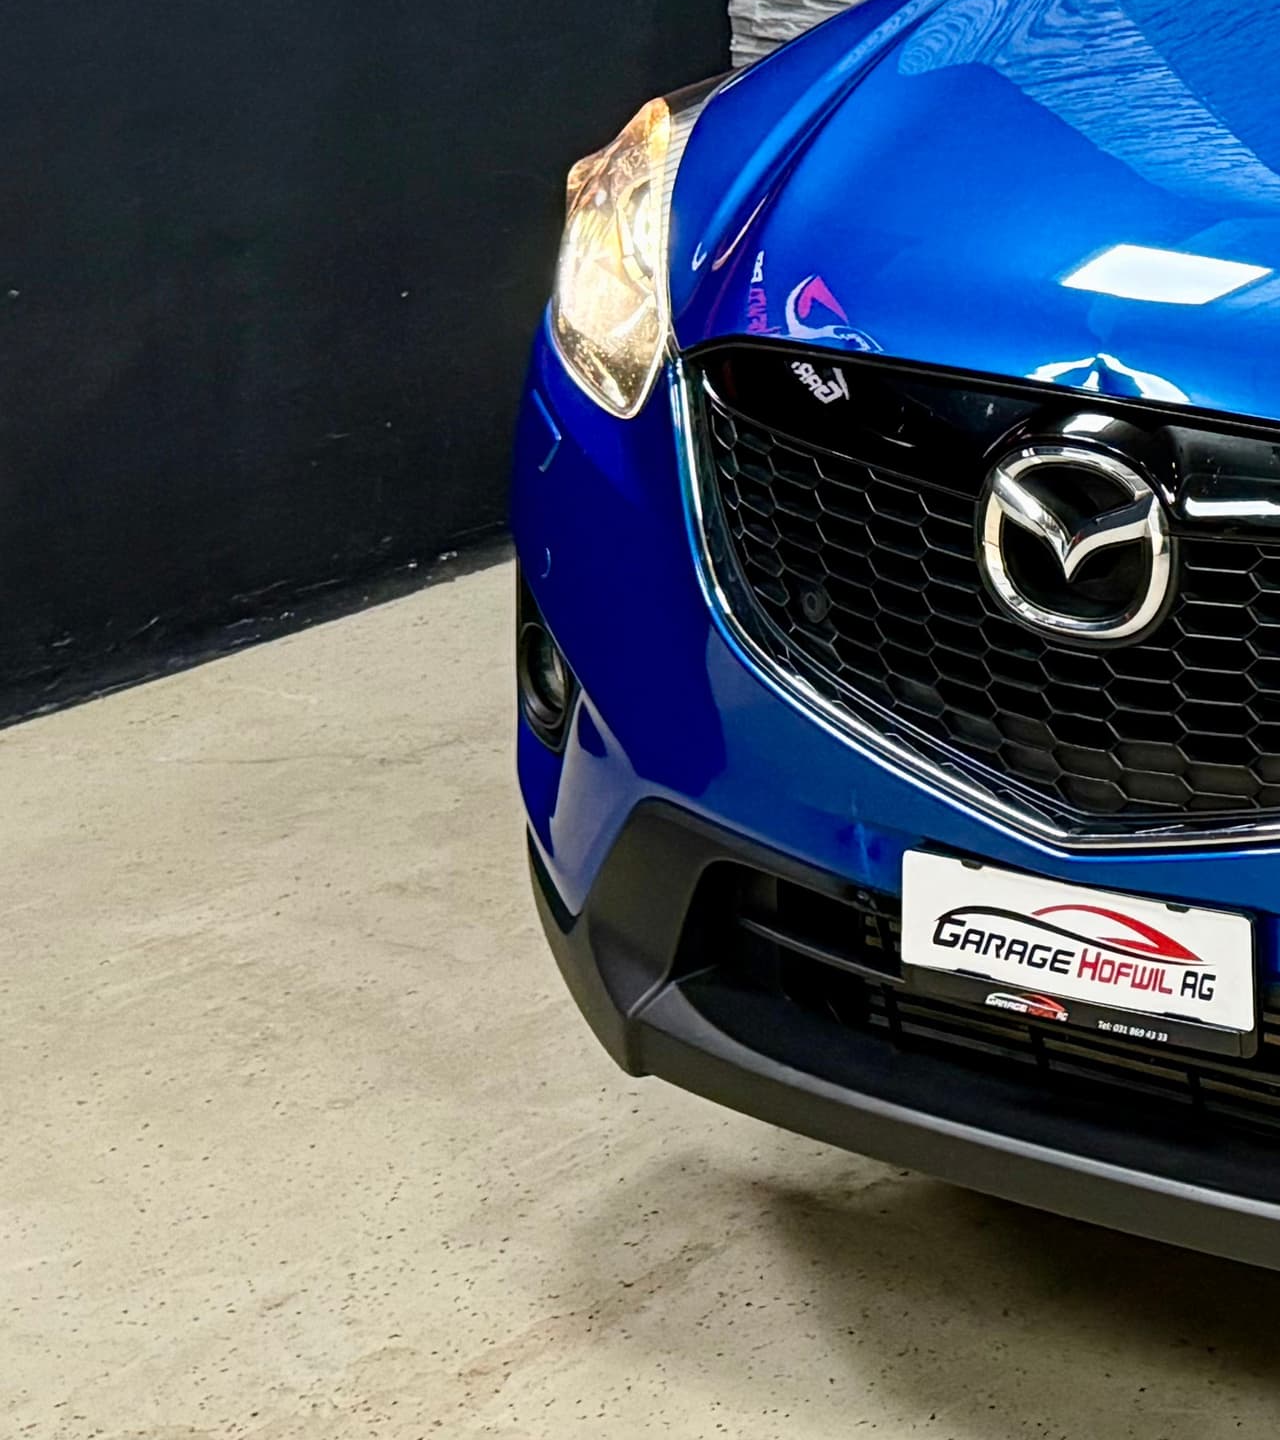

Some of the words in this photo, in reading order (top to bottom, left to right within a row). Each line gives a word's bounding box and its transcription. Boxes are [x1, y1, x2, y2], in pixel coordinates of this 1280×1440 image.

[932, 917, 1075, 975] GARAGE
[1077, 947, 1173, 995] HOFWIL
[1180, 970, 1217, 1001] AG
